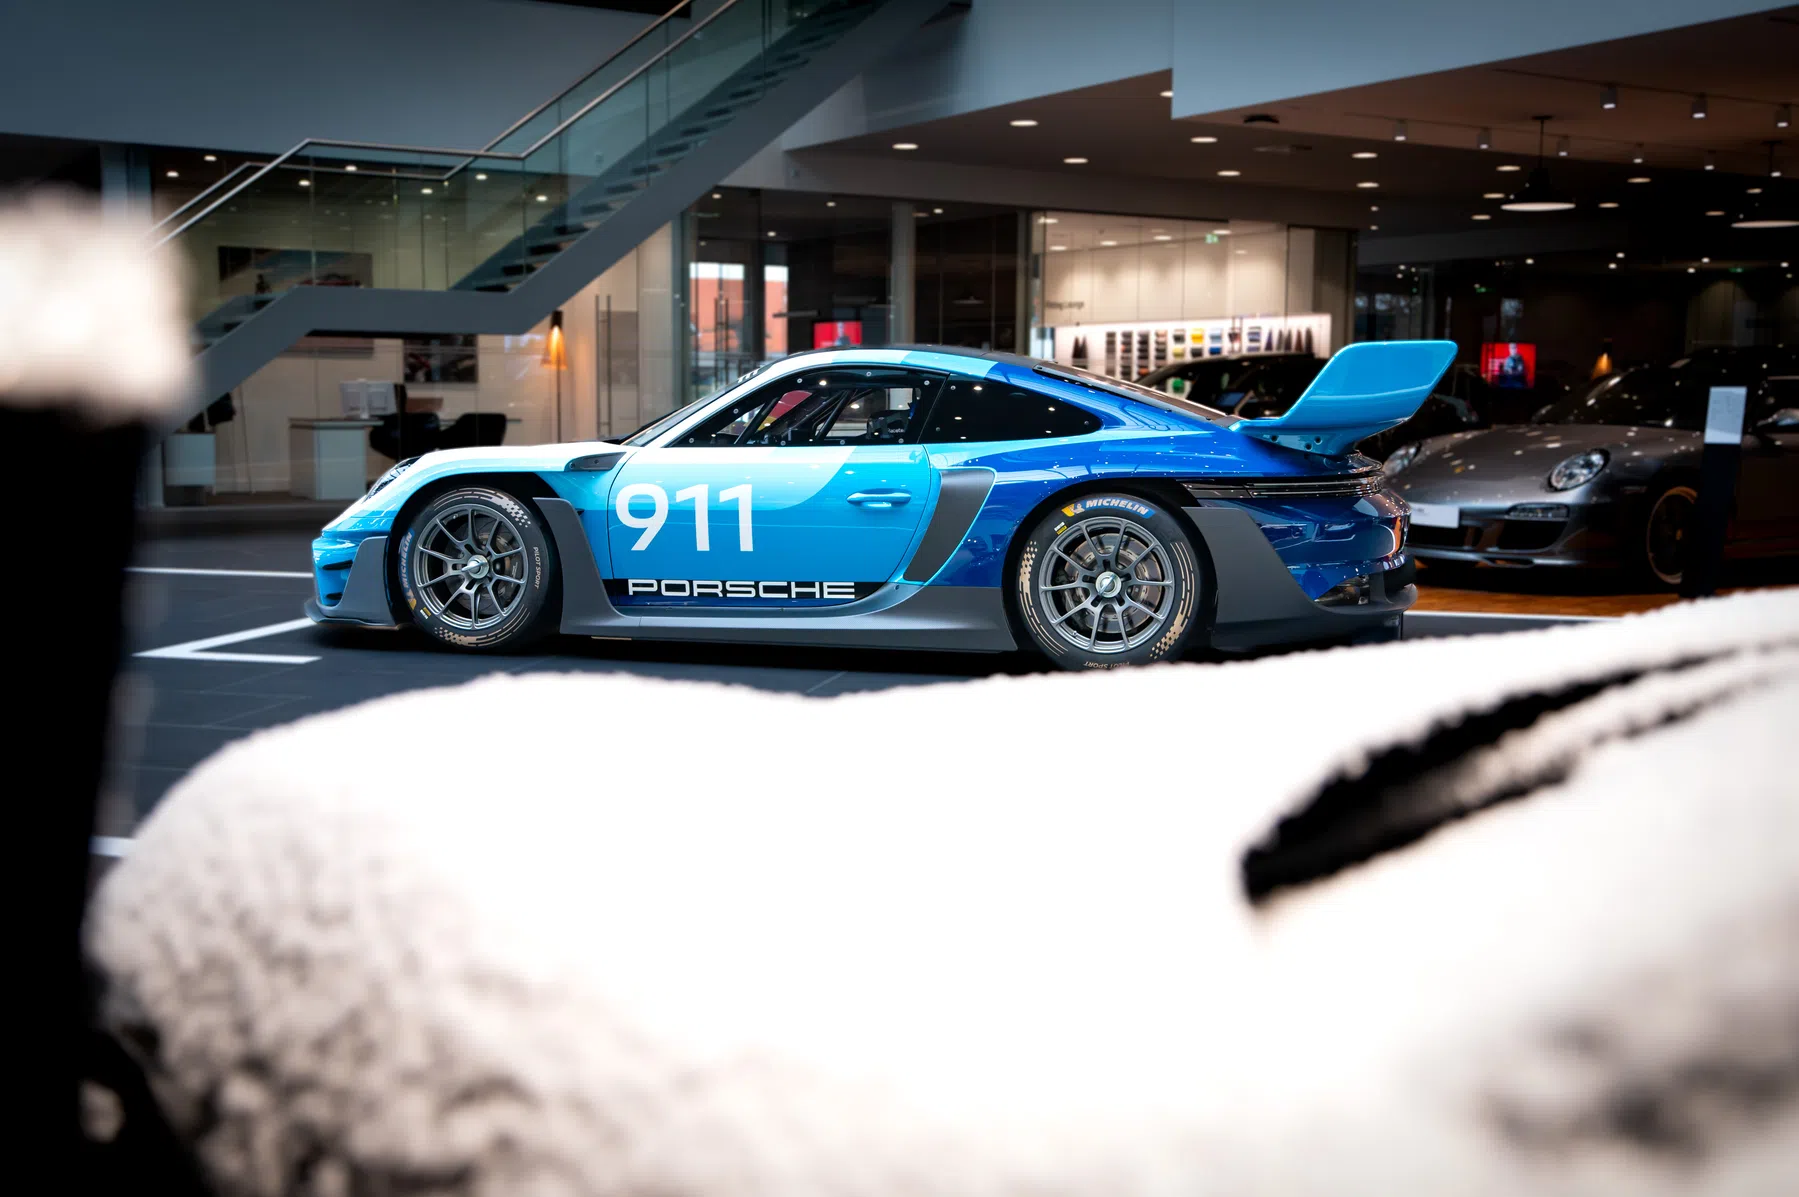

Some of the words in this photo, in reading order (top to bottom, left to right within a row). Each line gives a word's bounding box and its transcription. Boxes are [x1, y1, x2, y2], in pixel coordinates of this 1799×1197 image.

[1085, 498, 1149, 515] MICHELIN
[615, 483, 754, 552] 911
[401, 531, 412, 588] MICHELIN
[533, 546, 541, 566] PILOT
[627, 578, 855, 599] PORSCHE
